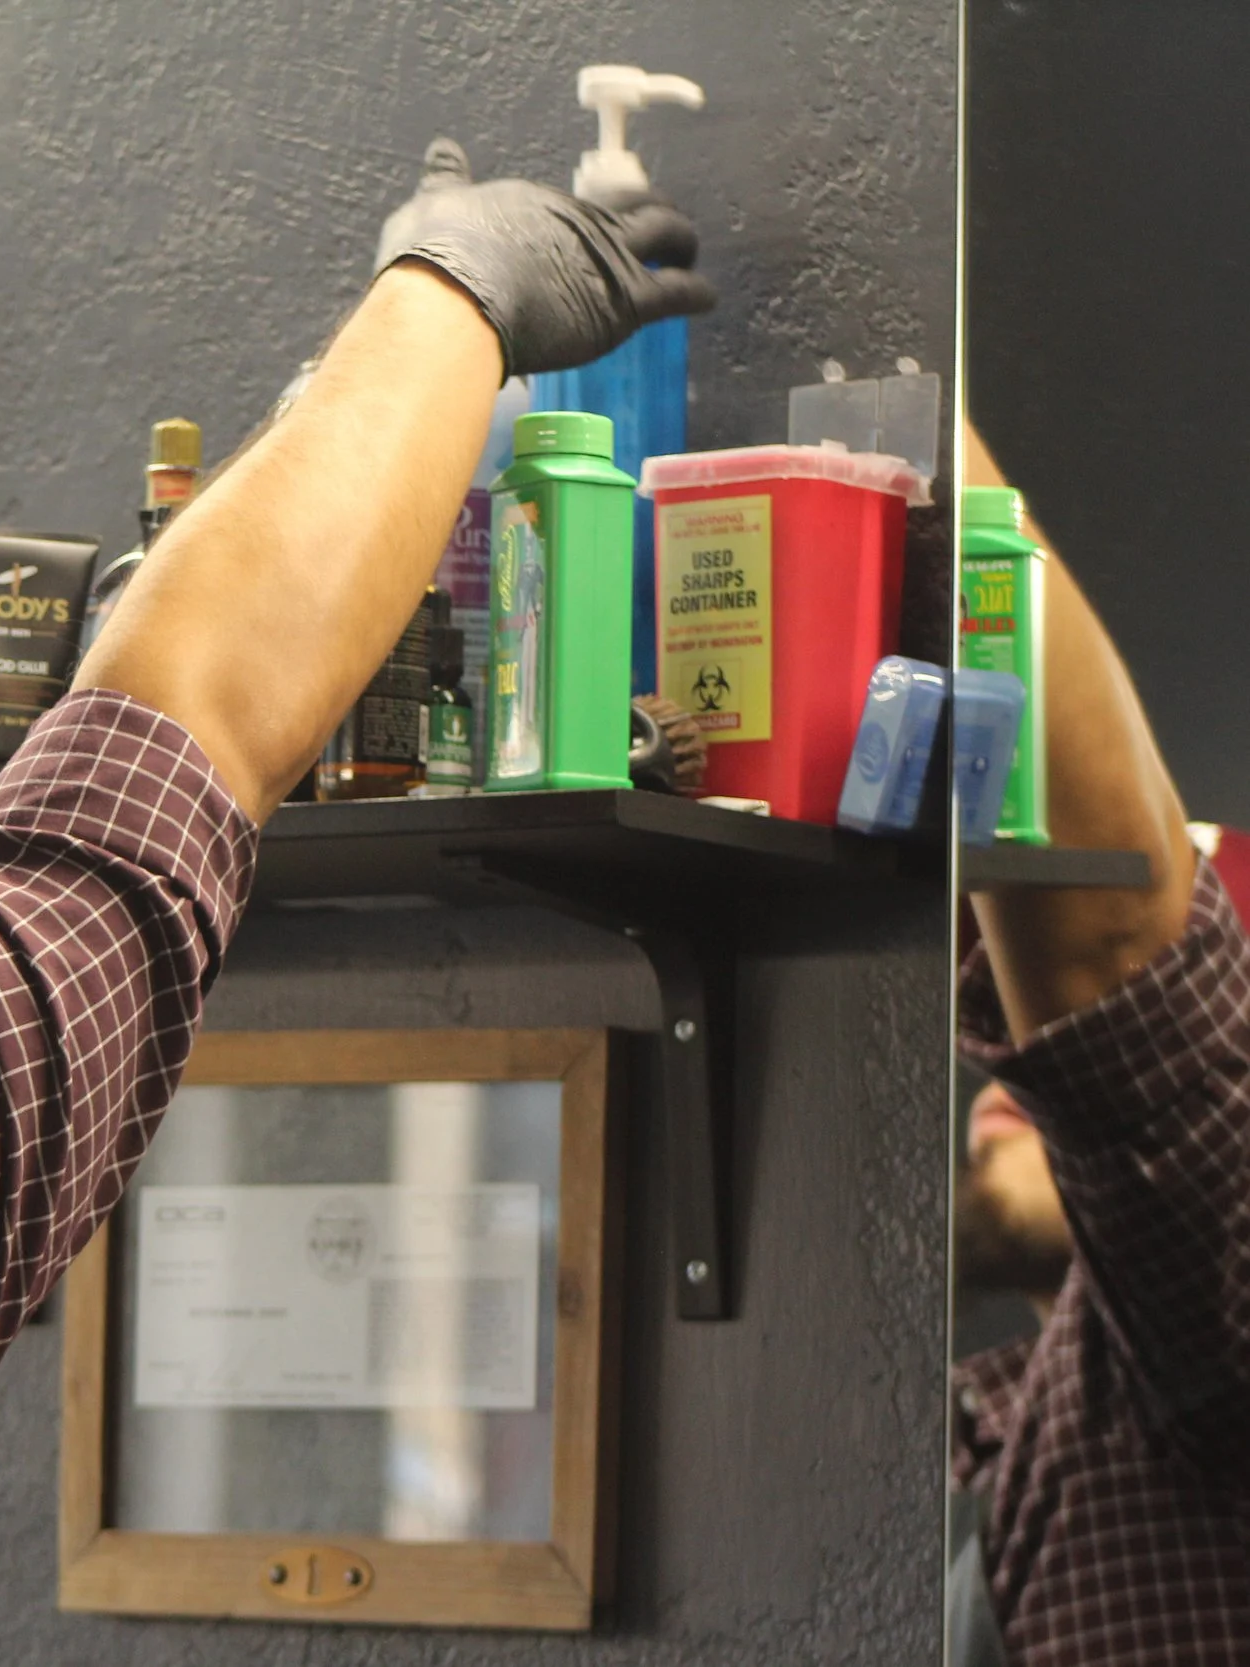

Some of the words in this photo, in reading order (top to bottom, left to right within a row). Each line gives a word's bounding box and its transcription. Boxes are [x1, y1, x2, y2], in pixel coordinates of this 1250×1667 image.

[691, 549, 733, 570] USED
[681, 568, 744, 592] SHARPS
[670, 589, 757, 615] CONTAINER
[16, 659, 49, 675] GLUE
